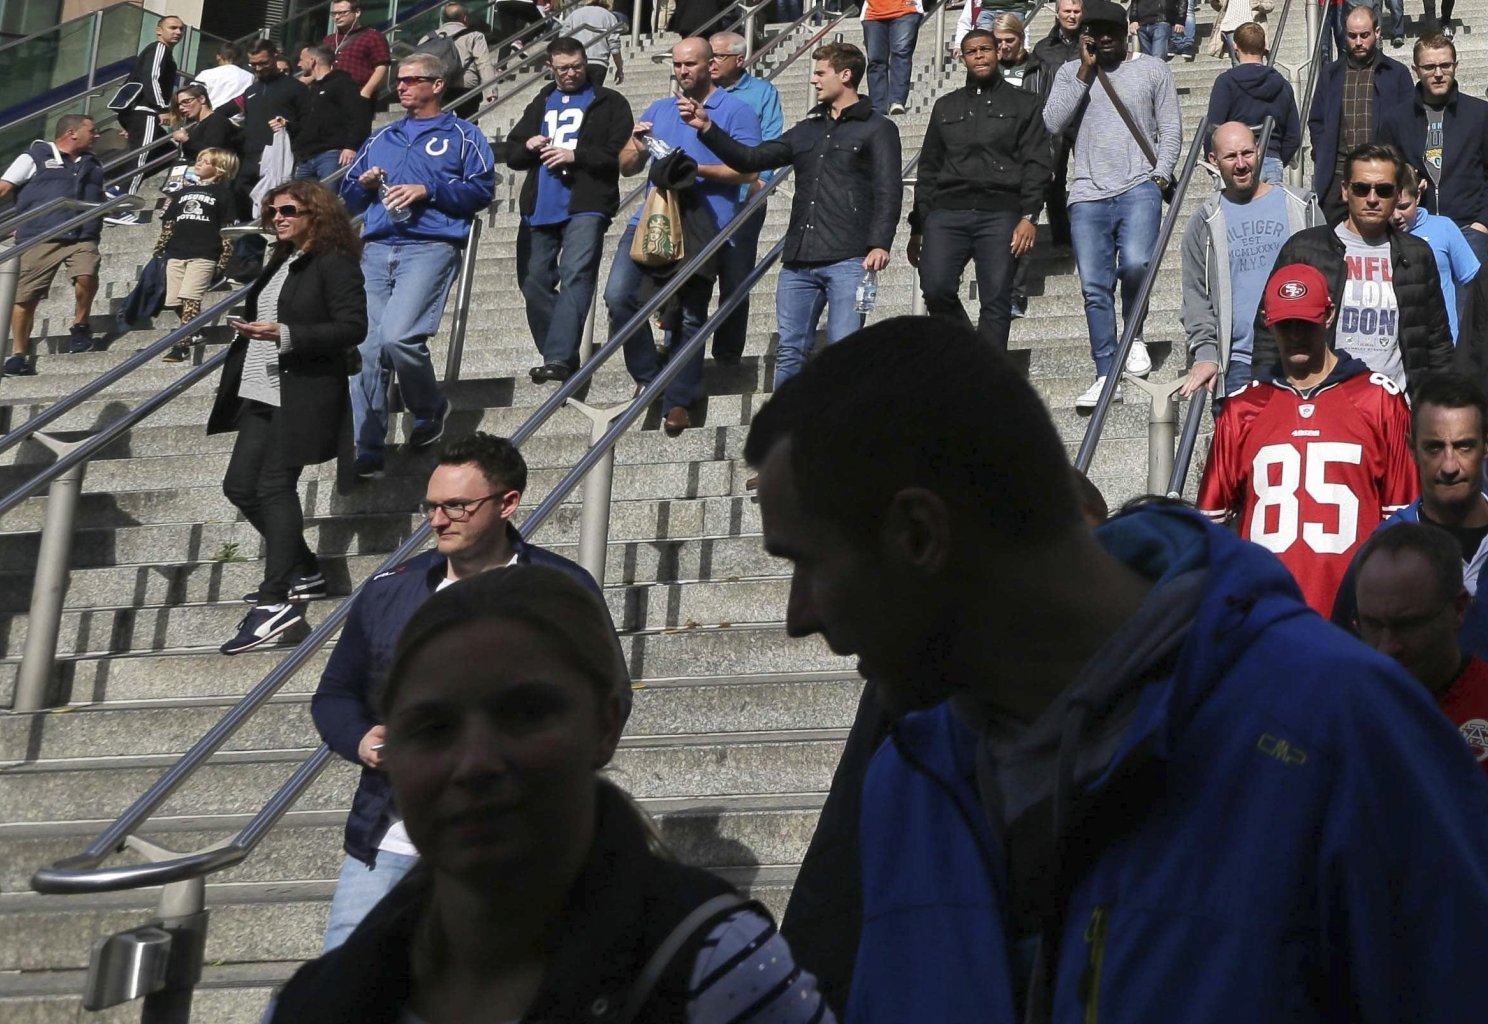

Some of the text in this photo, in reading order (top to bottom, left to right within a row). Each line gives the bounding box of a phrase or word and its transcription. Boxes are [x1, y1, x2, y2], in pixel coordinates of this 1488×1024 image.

[544, 107, 584, 150] 12
[1345, 256, 1394, 282] NFL
[1343, 280, 1398, 309] LON
[1341, 307, 1397, 336] DON
[1251, 441, 1363, 555] 85
